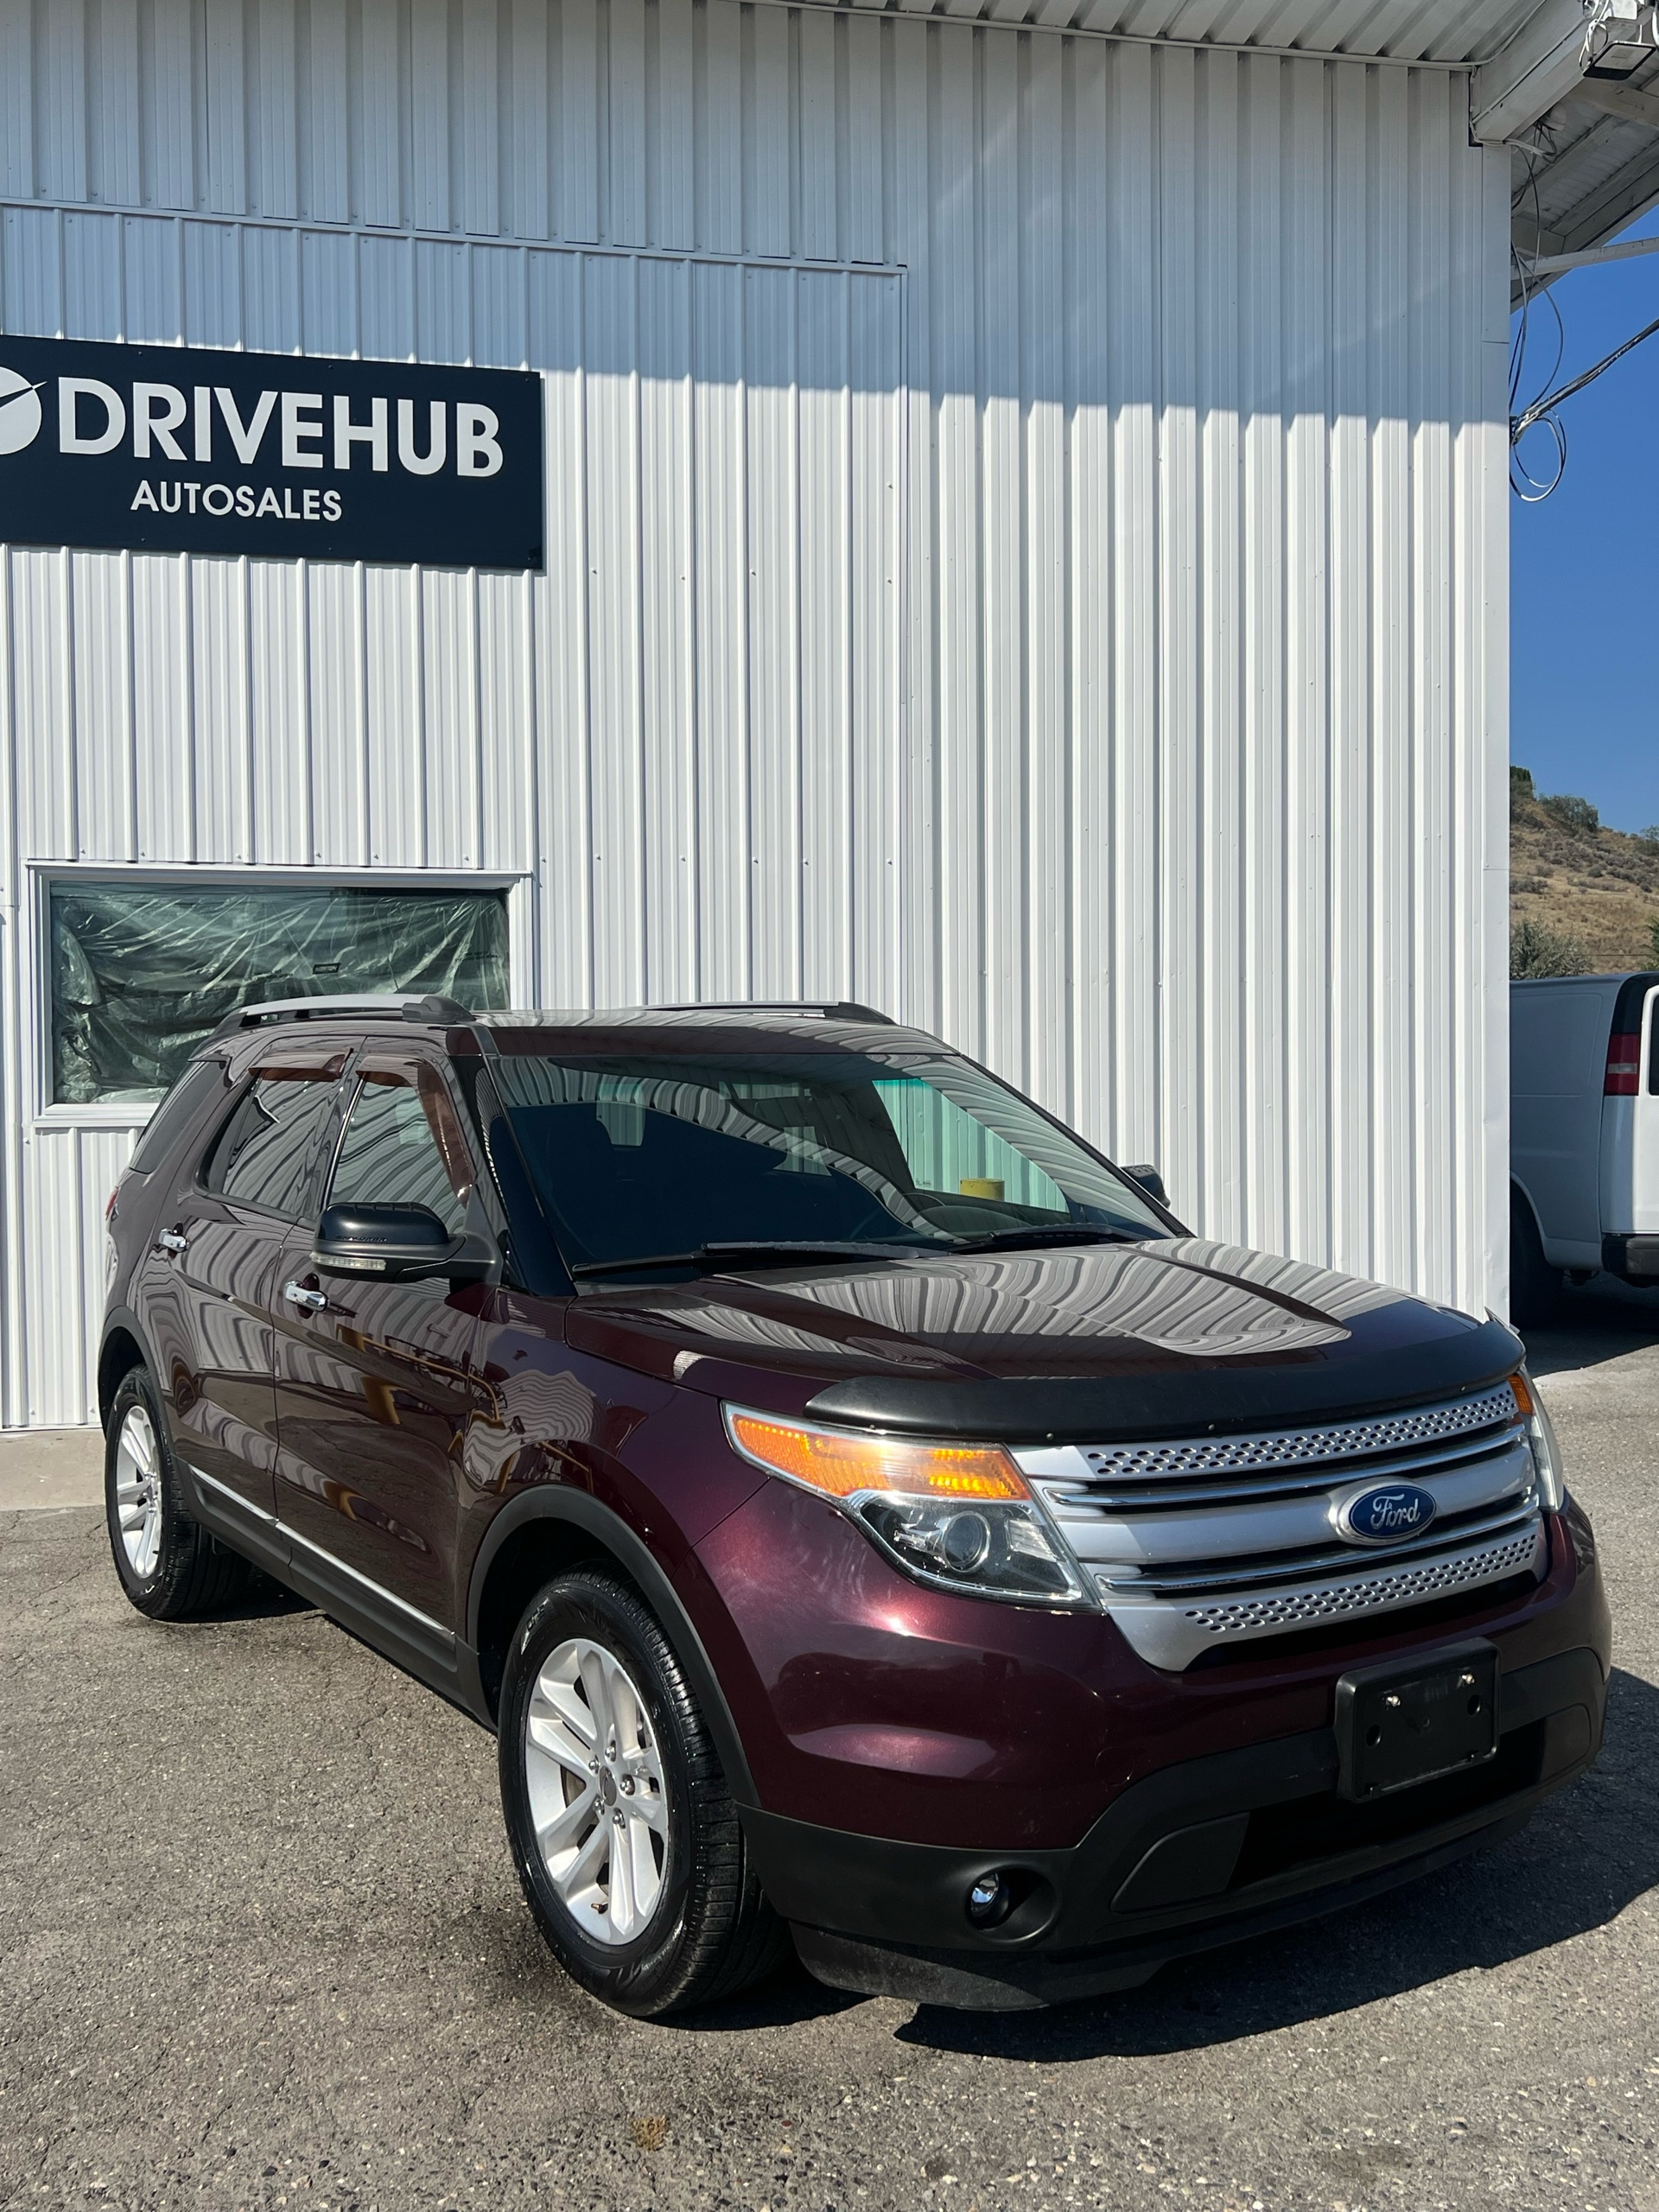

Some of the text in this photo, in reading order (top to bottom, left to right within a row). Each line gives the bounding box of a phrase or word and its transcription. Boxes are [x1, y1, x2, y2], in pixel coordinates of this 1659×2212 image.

[58, 377, 504, 478] DRIVEHUB
[130, 480, 342, 522] AUTOSALES
[1370, 1494, 1421, 1529] Ford
